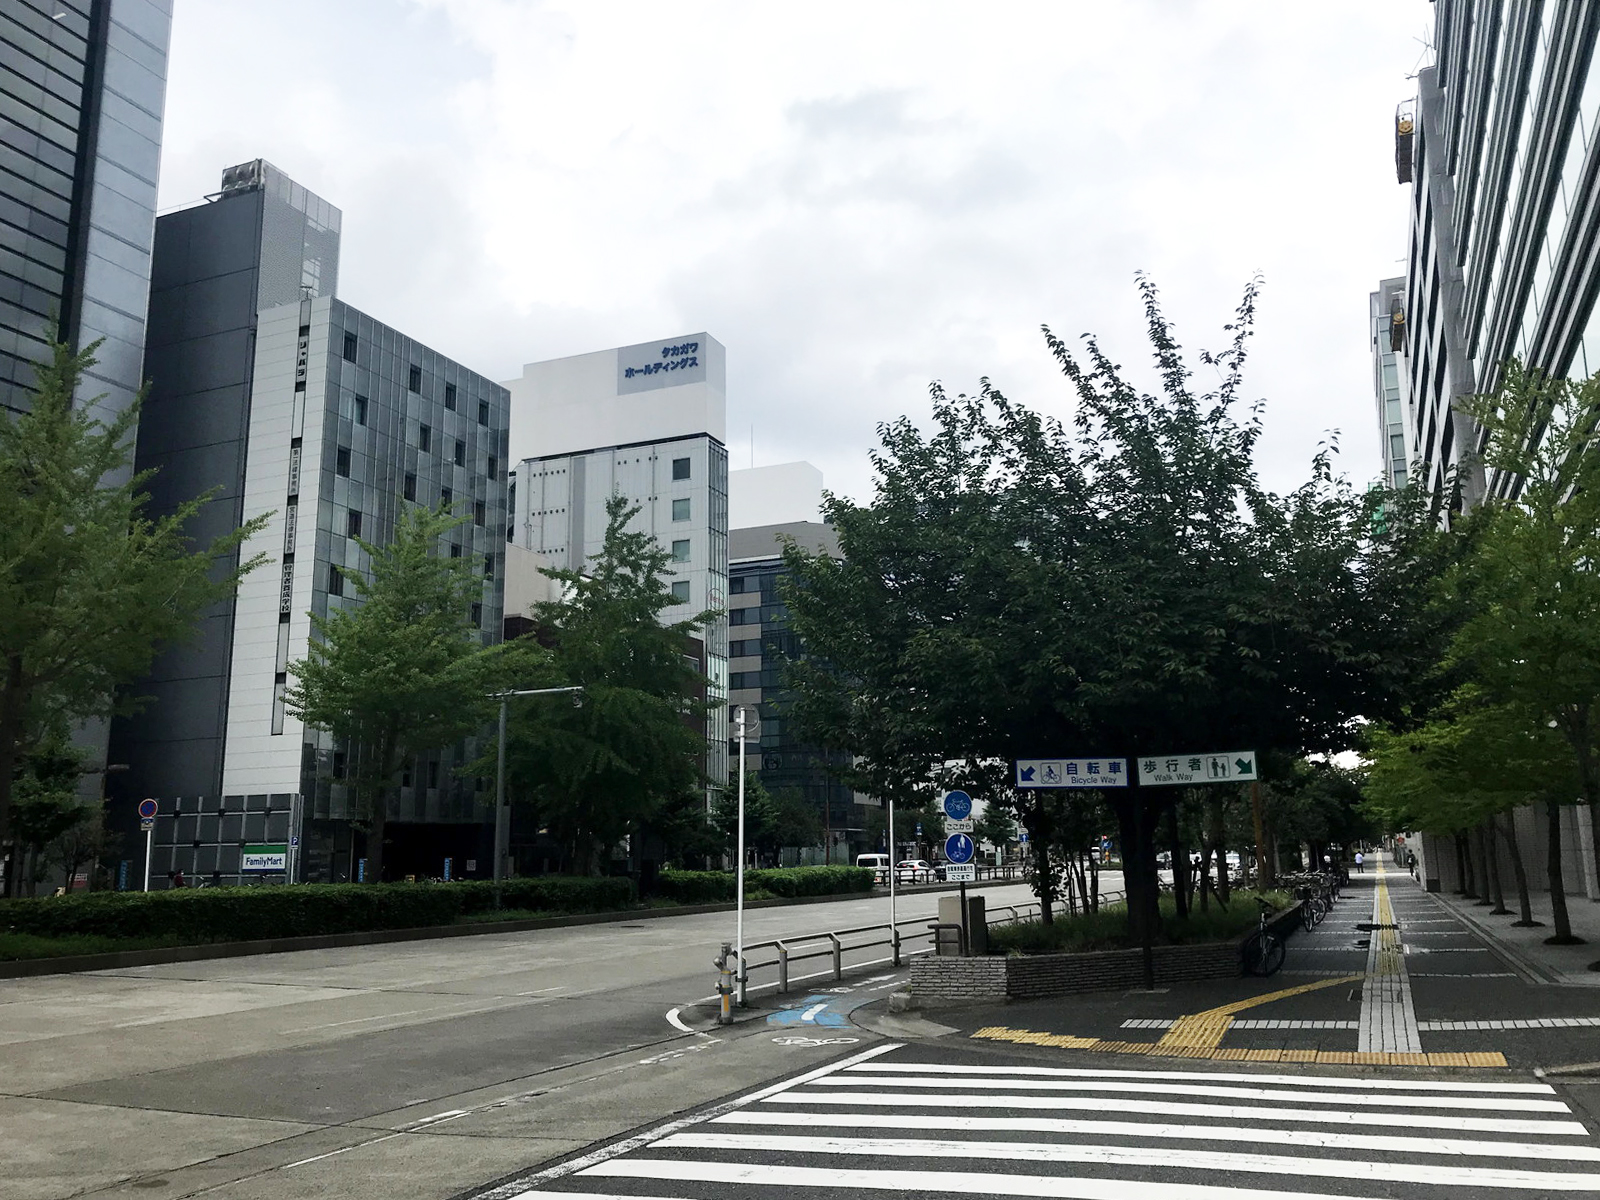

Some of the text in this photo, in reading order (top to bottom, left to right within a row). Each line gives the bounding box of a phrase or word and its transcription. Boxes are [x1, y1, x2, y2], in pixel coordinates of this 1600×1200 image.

[661, 342, 699, 358] タカガワ
[624, 356, 699, 379] ホールディングス
[1066, 761, 1122, 775] 自転車
[1143, 757, 1202, 774] 歩行者
[1071, 776, 1117, 785] Bicycle Way
[1153, 773, 1193, 782] Walk Way
[946, 822, 972, 830] ここから
[246, 857, 282, 867] FamilyMart
